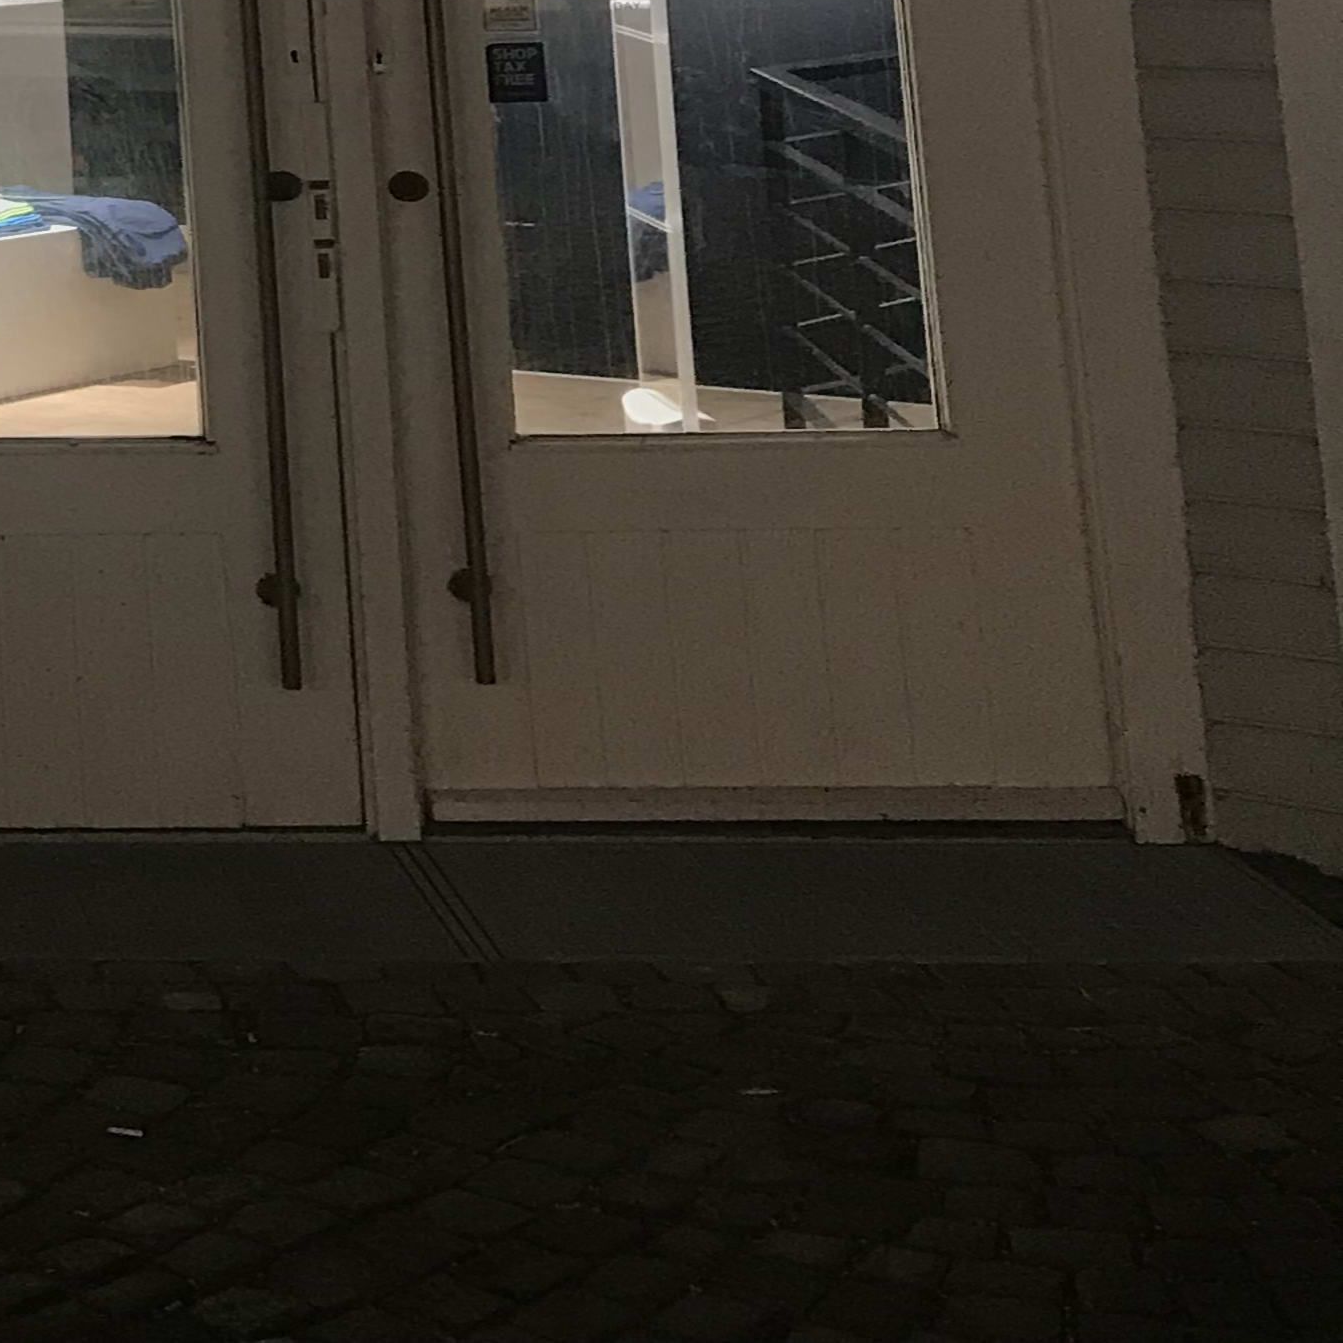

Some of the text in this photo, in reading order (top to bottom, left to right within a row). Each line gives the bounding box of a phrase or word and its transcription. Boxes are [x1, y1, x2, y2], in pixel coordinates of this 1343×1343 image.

[492, 48, 538, 61] SHOP
[494, 61, 527, 73] TAX
[494, 73, 536, 86] FREE
